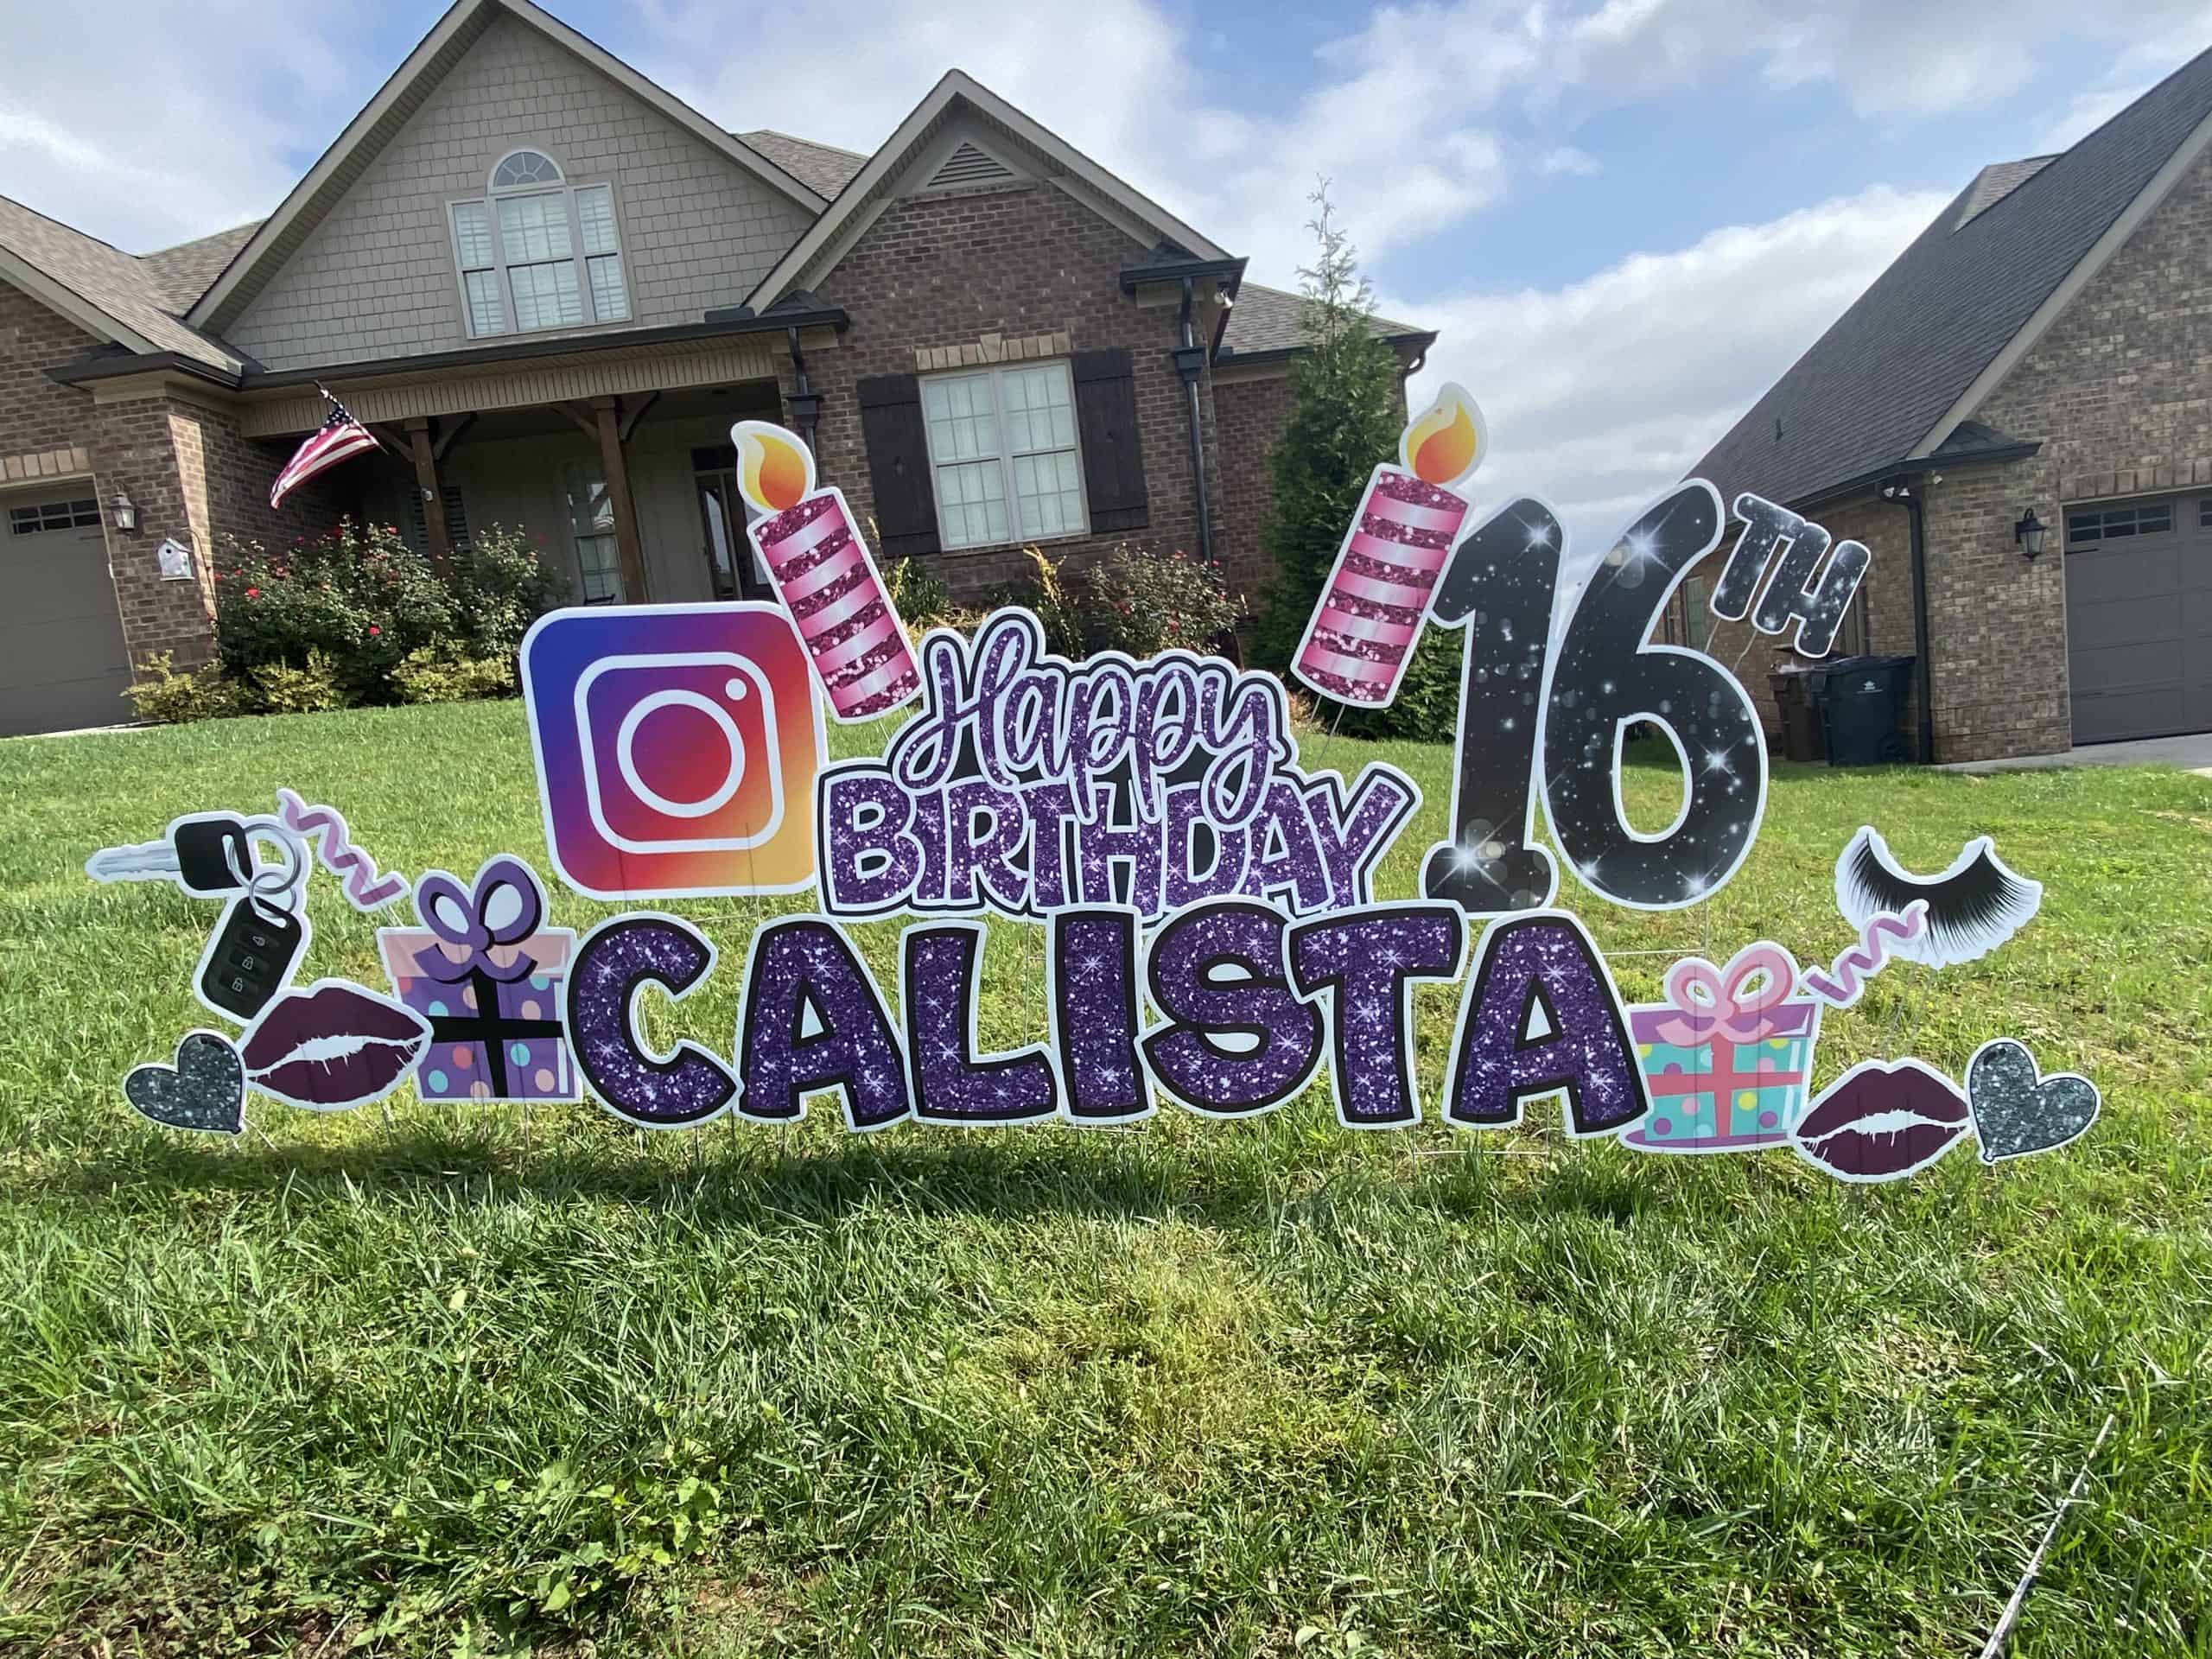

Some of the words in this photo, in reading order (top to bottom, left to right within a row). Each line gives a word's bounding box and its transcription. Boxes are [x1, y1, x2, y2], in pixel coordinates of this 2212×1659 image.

[897, 624, 1282, 823] Happy
[825, 771, 1407, 916] BIRTHDAY
[567, 904, 1649, 1134] CALISTA
